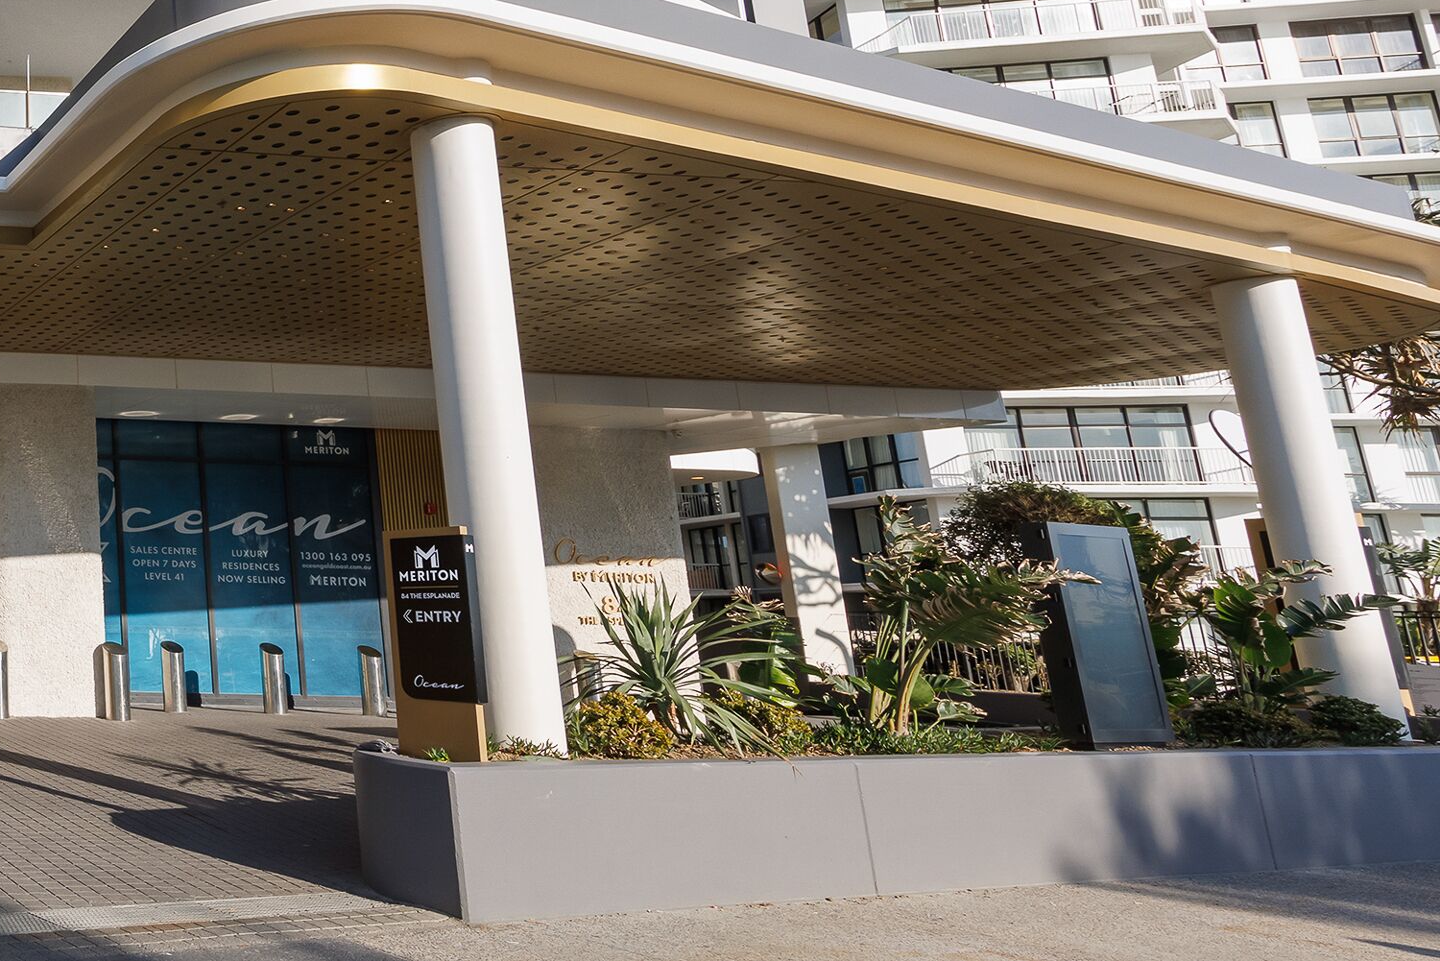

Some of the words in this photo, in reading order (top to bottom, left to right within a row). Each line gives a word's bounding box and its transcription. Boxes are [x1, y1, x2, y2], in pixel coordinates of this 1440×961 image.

[304, 446, 350, 455] MERITON
[130, 545, 159, 555] SALES
[161, 546, 198, 556] CENTRE
[231, 549, 269, 558] LUXURY
[554, 538, 672, 567] Ocean
[300, 551, 326, 561] 1300
[329, 552, 348, 562] 163
[351, 553, 372, 562] 095
[132, 558, 160, 567] OPEN
[163, 559, 169, 568] 7
[171, 559, 198, 569] DAYS
[222, 561, 280, 572] RESIDENCES
[144, 571, 172, 581] LEVEL
[174, 572, 185, 581] 41
[217, 574, 244, 583] NOW
[246, 575, 286, 585] SELLING
[309, 574, 367, 587] MERITON
[399, 569, 459, 582] MERITON
[410, 592, 423, 600] THE
[422, 591, 461, 600] ESPLANADE
[415, 610, 462, 623] ENTRY
[413, 674, 465, 690] Ocean
